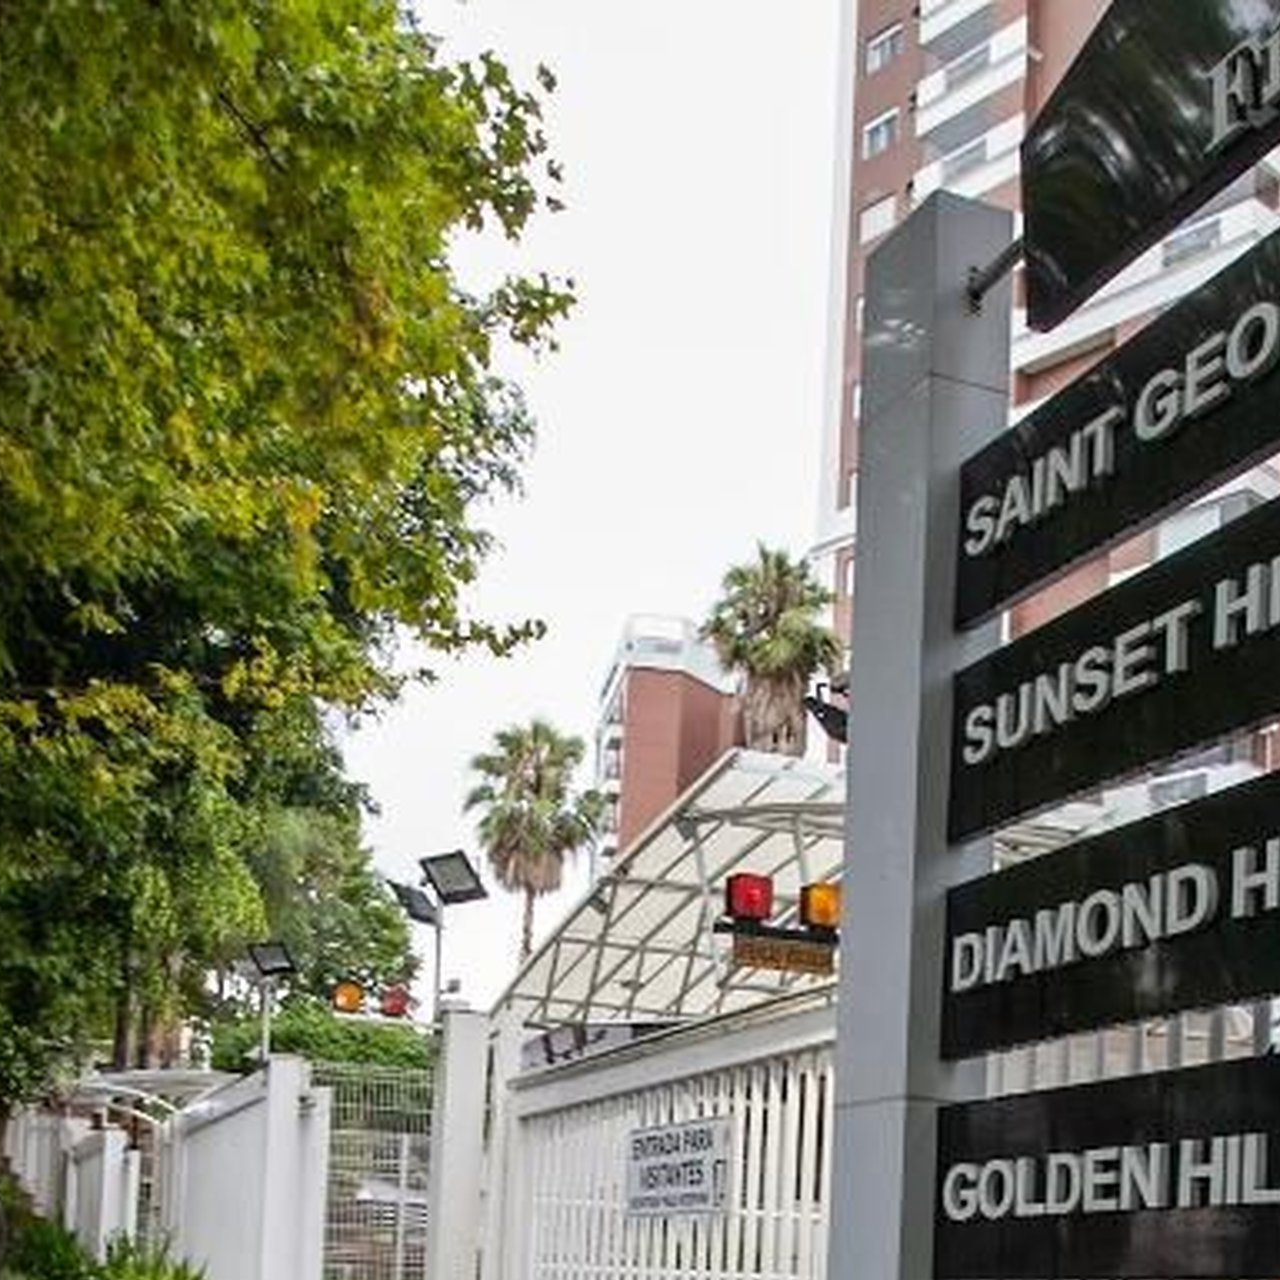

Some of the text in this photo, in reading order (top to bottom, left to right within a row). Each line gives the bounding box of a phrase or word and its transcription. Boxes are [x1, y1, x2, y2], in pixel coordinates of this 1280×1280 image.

[964, 406, 1126, 557] SAINT
[963, 600, 1202, 765] SUNSET
[951, 863, 1217, 994] DIAMOND
[942, 1142, 1170, 1221] GOLDEN
